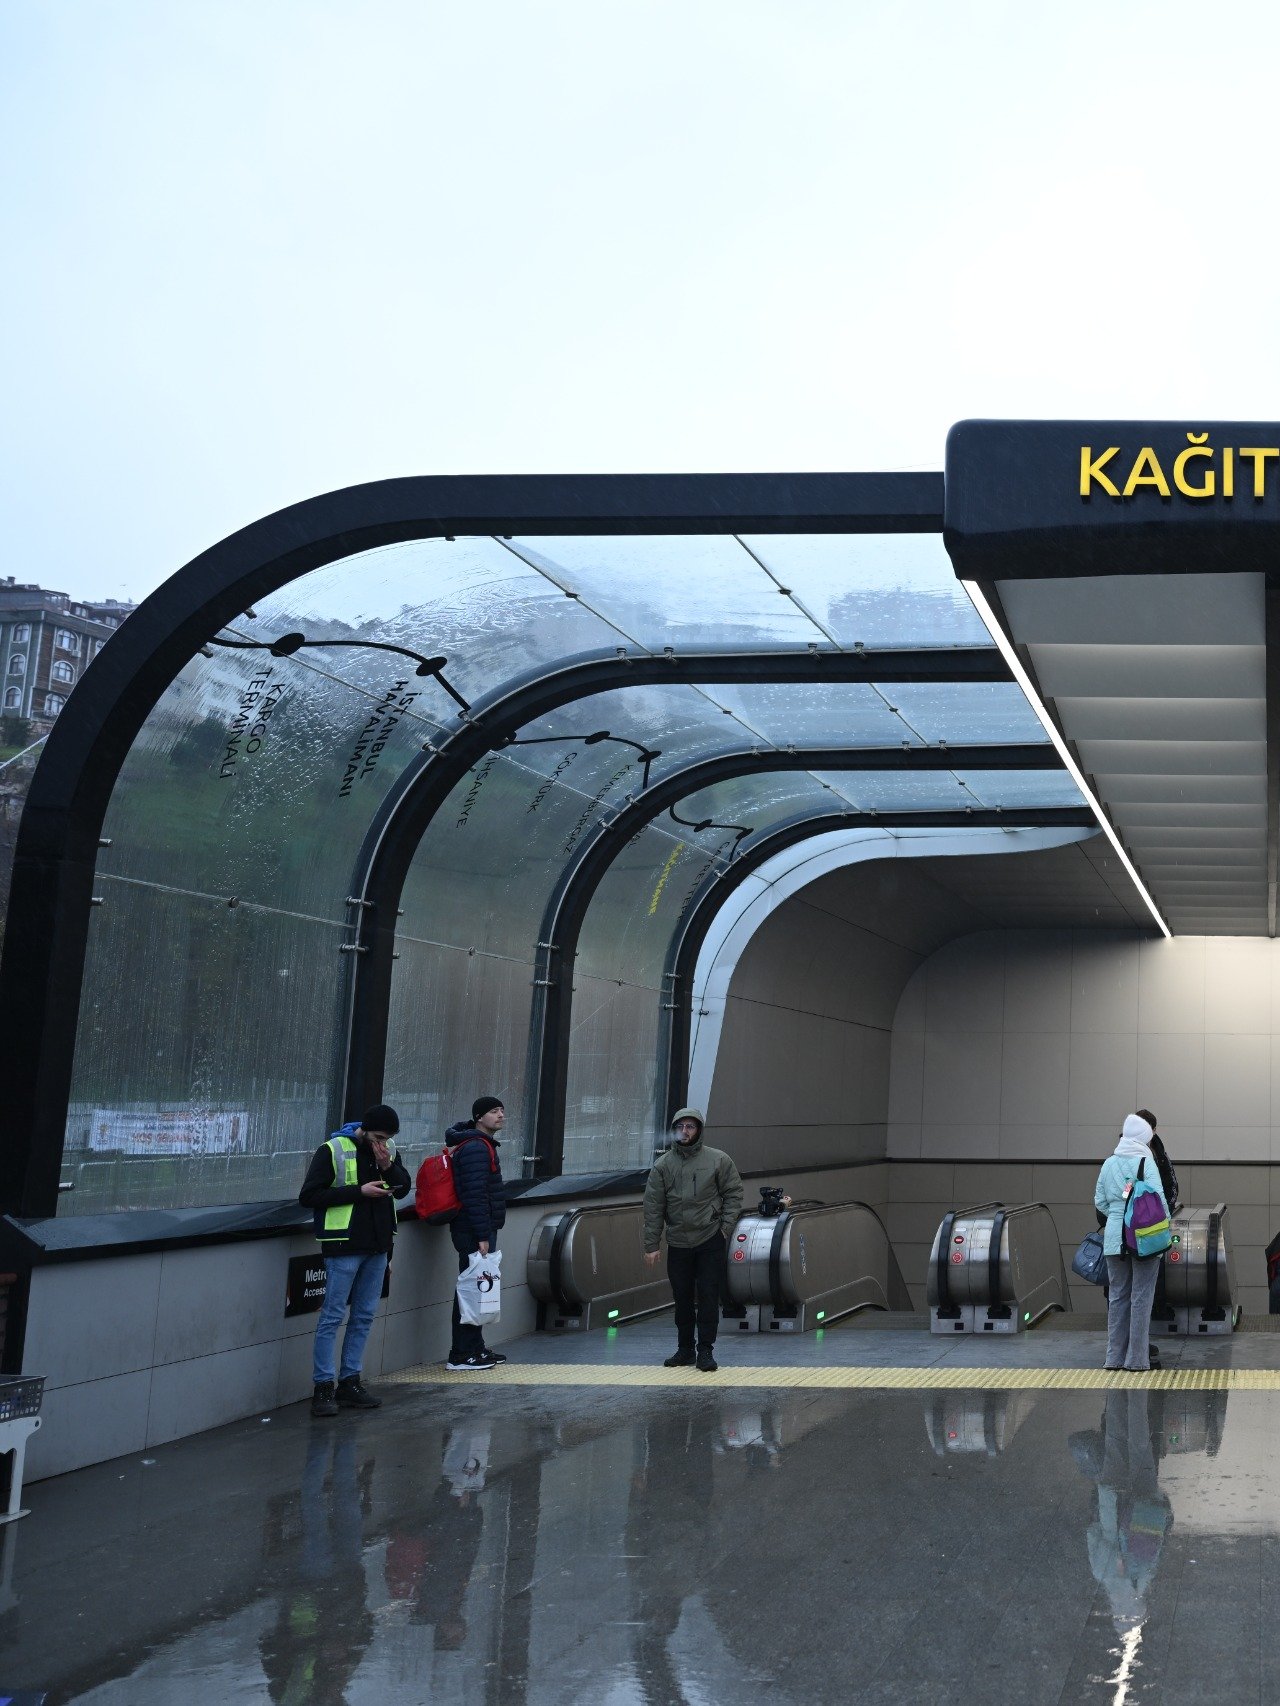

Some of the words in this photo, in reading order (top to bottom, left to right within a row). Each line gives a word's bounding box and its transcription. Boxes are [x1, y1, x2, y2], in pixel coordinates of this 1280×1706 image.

[219, 667, 273, 779] TERMİNALİ
[246, 683, 286, 754] KARGO
[339, 681, 410, 798] HAVALİMANI
[360, 692, 423, 780] İSTANBUL
[303, 1286, 327, 1298] Access
